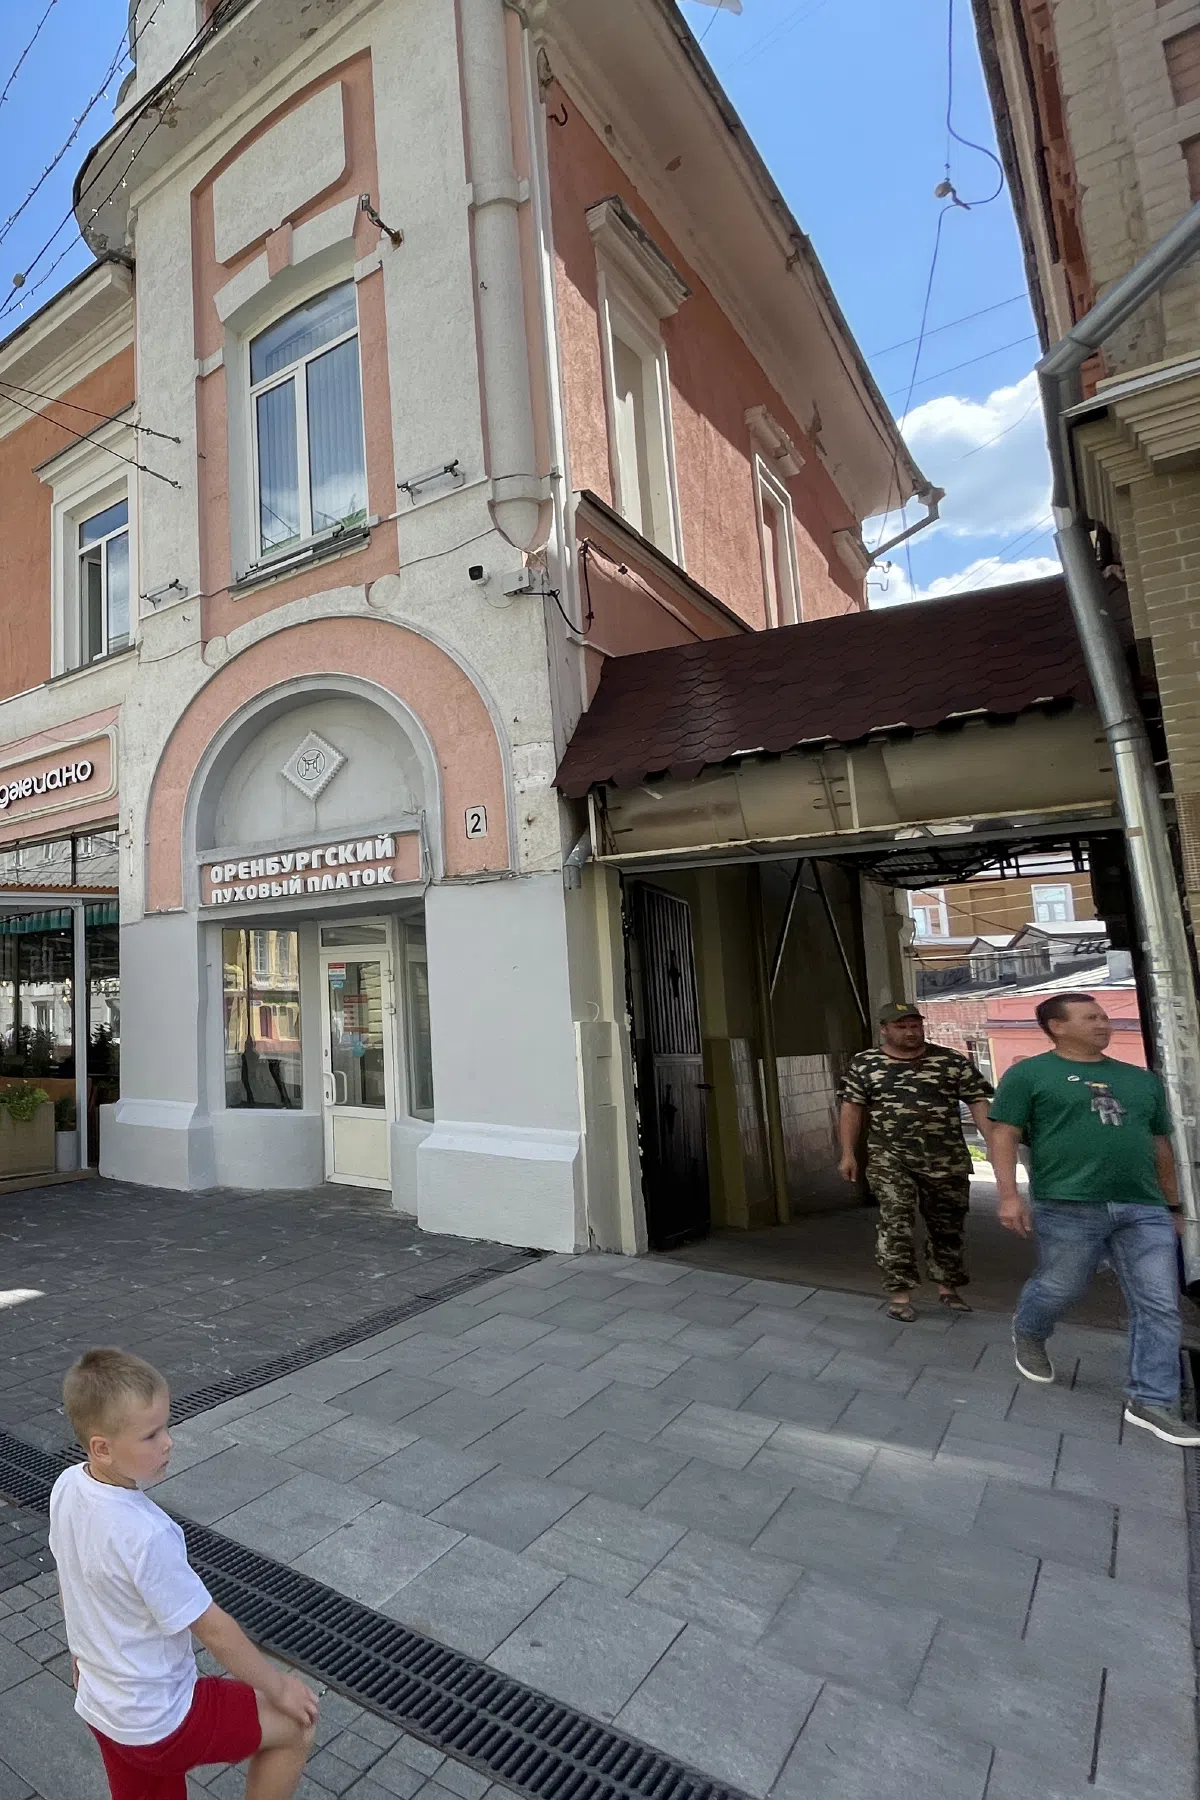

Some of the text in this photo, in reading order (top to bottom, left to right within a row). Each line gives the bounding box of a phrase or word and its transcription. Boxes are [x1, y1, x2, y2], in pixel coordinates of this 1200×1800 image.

[470, 813, 482, 834] 2
[210, 834, 395, 884] ОРЕНБУРГСКИЙ
[211, 865, 393, 904] ПУХОВЫЙ ПЛАТОК
